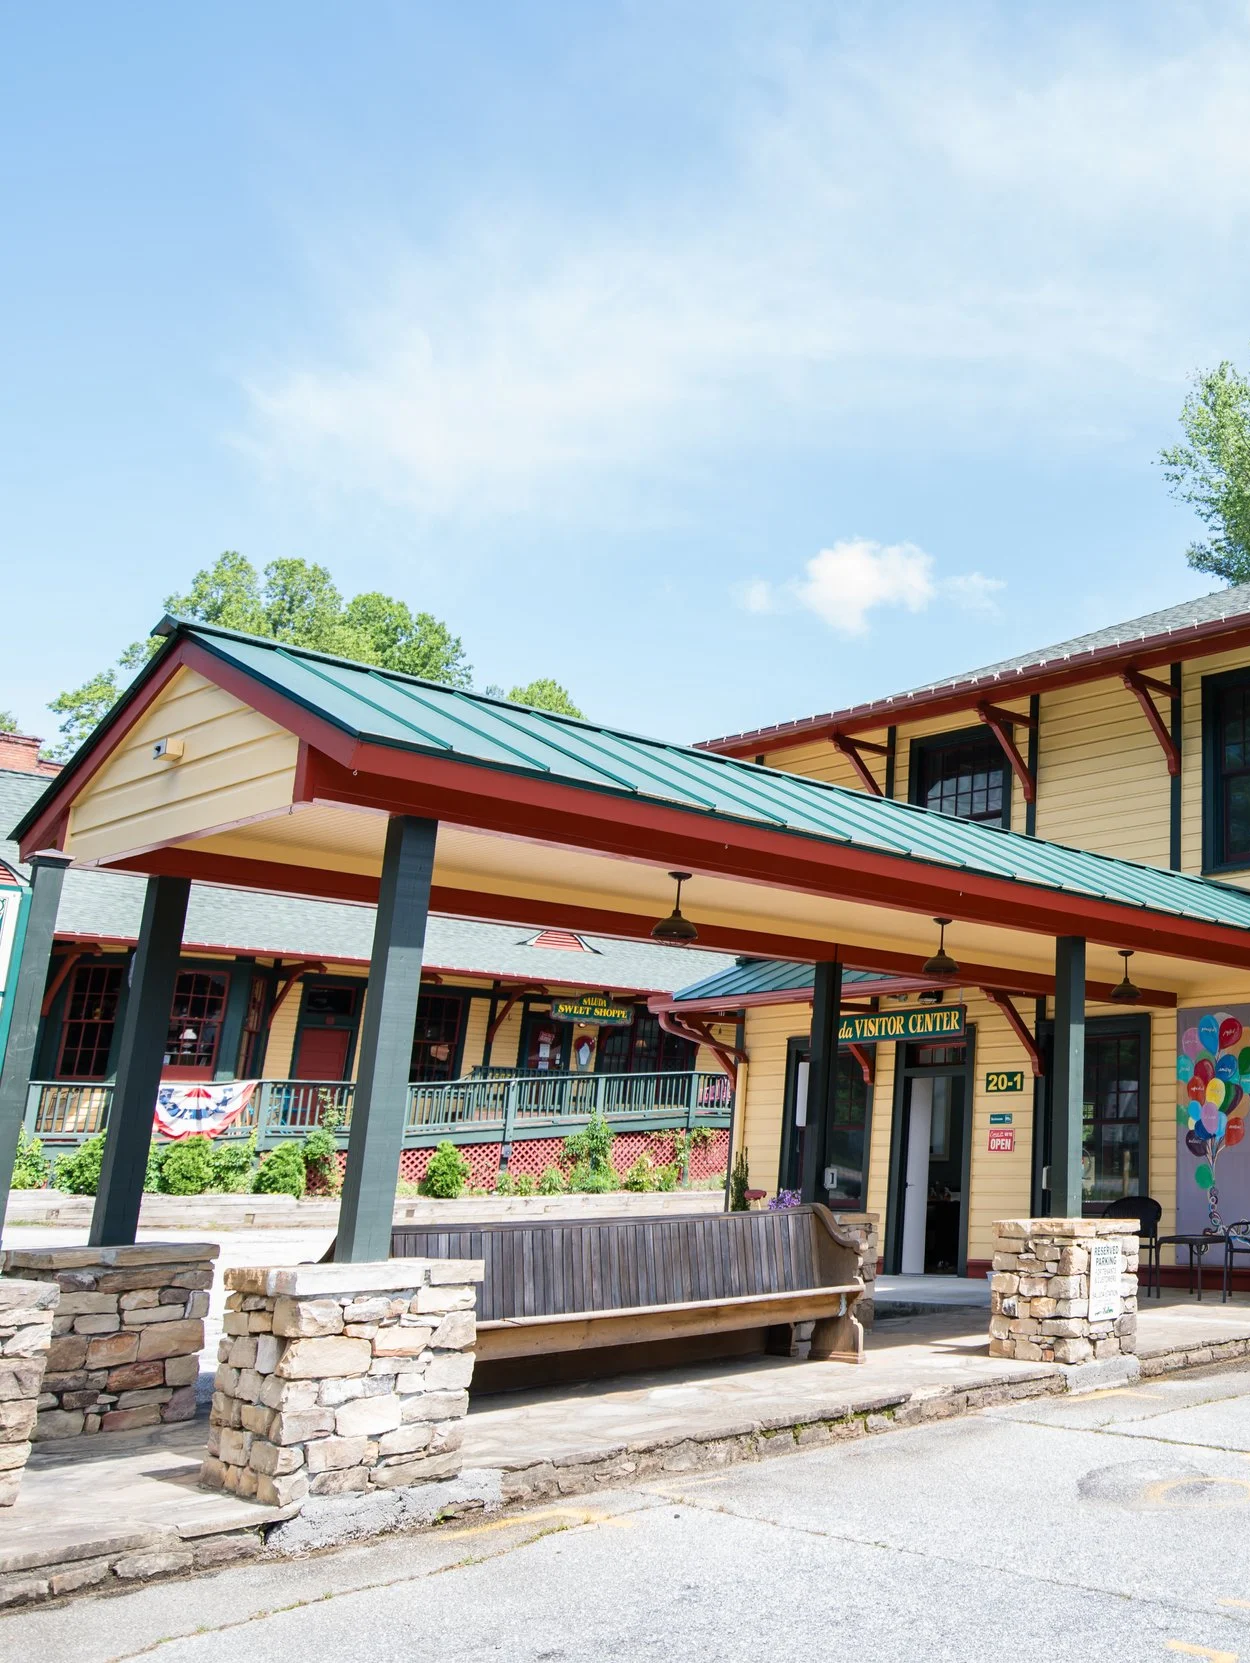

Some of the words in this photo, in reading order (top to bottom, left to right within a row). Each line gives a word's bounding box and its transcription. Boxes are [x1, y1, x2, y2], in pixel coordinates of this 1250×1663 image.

[582, 997, 607, 1007] SALUDA
[558, 1004, 592, 1015] SWEET
[593, 1007, 628, 1018] SHOPPE
[855, 1015, 905, 1038] VISITOR
[908, 1010, 960, 1034] CENTER
[988, 1073, 1022, 1090] 20-1
[990, 1138, 1011, 1150] OPEN
[1094, 1245, 1119, 1256] RESERVED
[1096, 1255, 1117, 1266] PARKING
